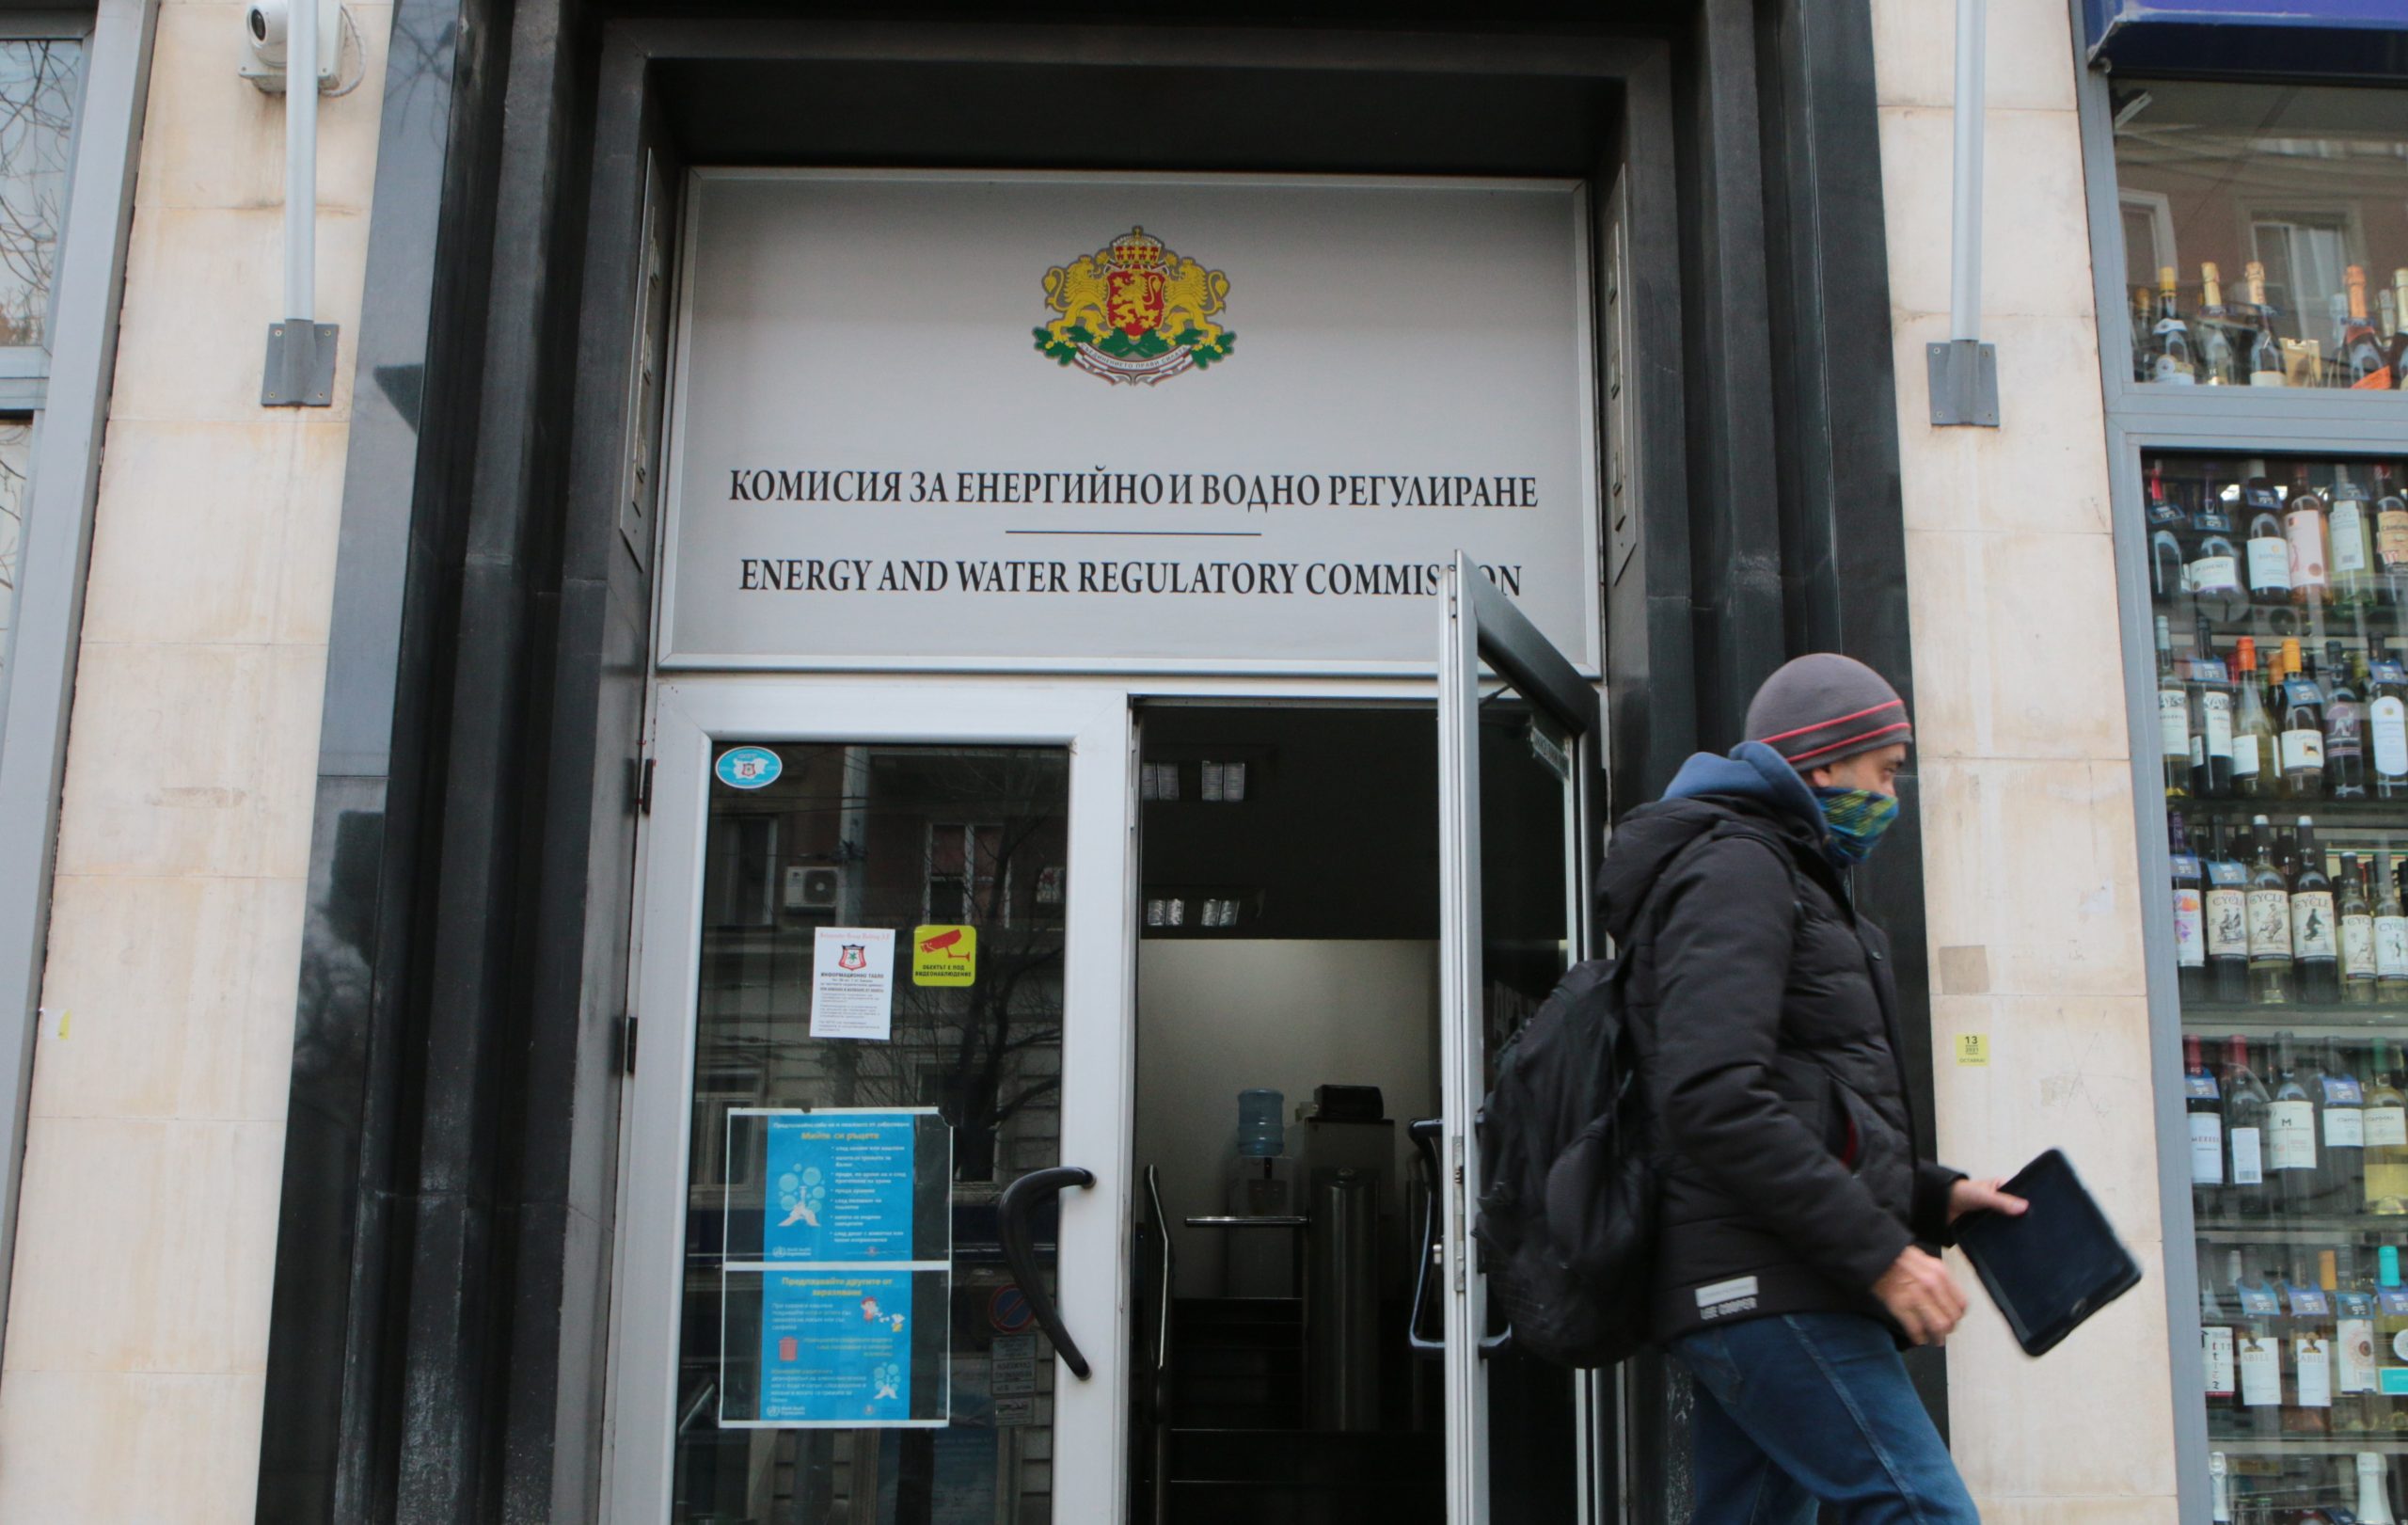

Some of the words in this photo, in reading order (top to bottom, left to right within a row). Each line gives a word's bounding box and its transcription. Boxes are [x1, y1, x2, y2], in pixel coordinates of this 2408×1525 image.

[1080, 343, 1133, 369] СЪЕДИНЕНИЕТО
[1135, 360, 1161, 369] ПРАВИ
[1161, 345, 1187, 363] СИЛАТА
[729, 470, 903, 501] КОМИСИЯ
[910, 471, 950, 502] ЗА
[956, 465, 1164, 505] ЕНЕРГИЙНО
[1169, 473, 1194, 505] И
[1201, 474, 1321, 513] ВОДНО
[1328, 475, 1539, 508] РЕГУЛИРАНЕ
[739, 559, 873, 591] ENERGY
[877, 560, 949, 592] AND
[956, 561, 1069, 593] WATER
[1078, 562, 1299, 595] REGULATORY
[1306, 564, 1522, 596] COMMISN
[1965, 1036, 1978, 1044] 13
